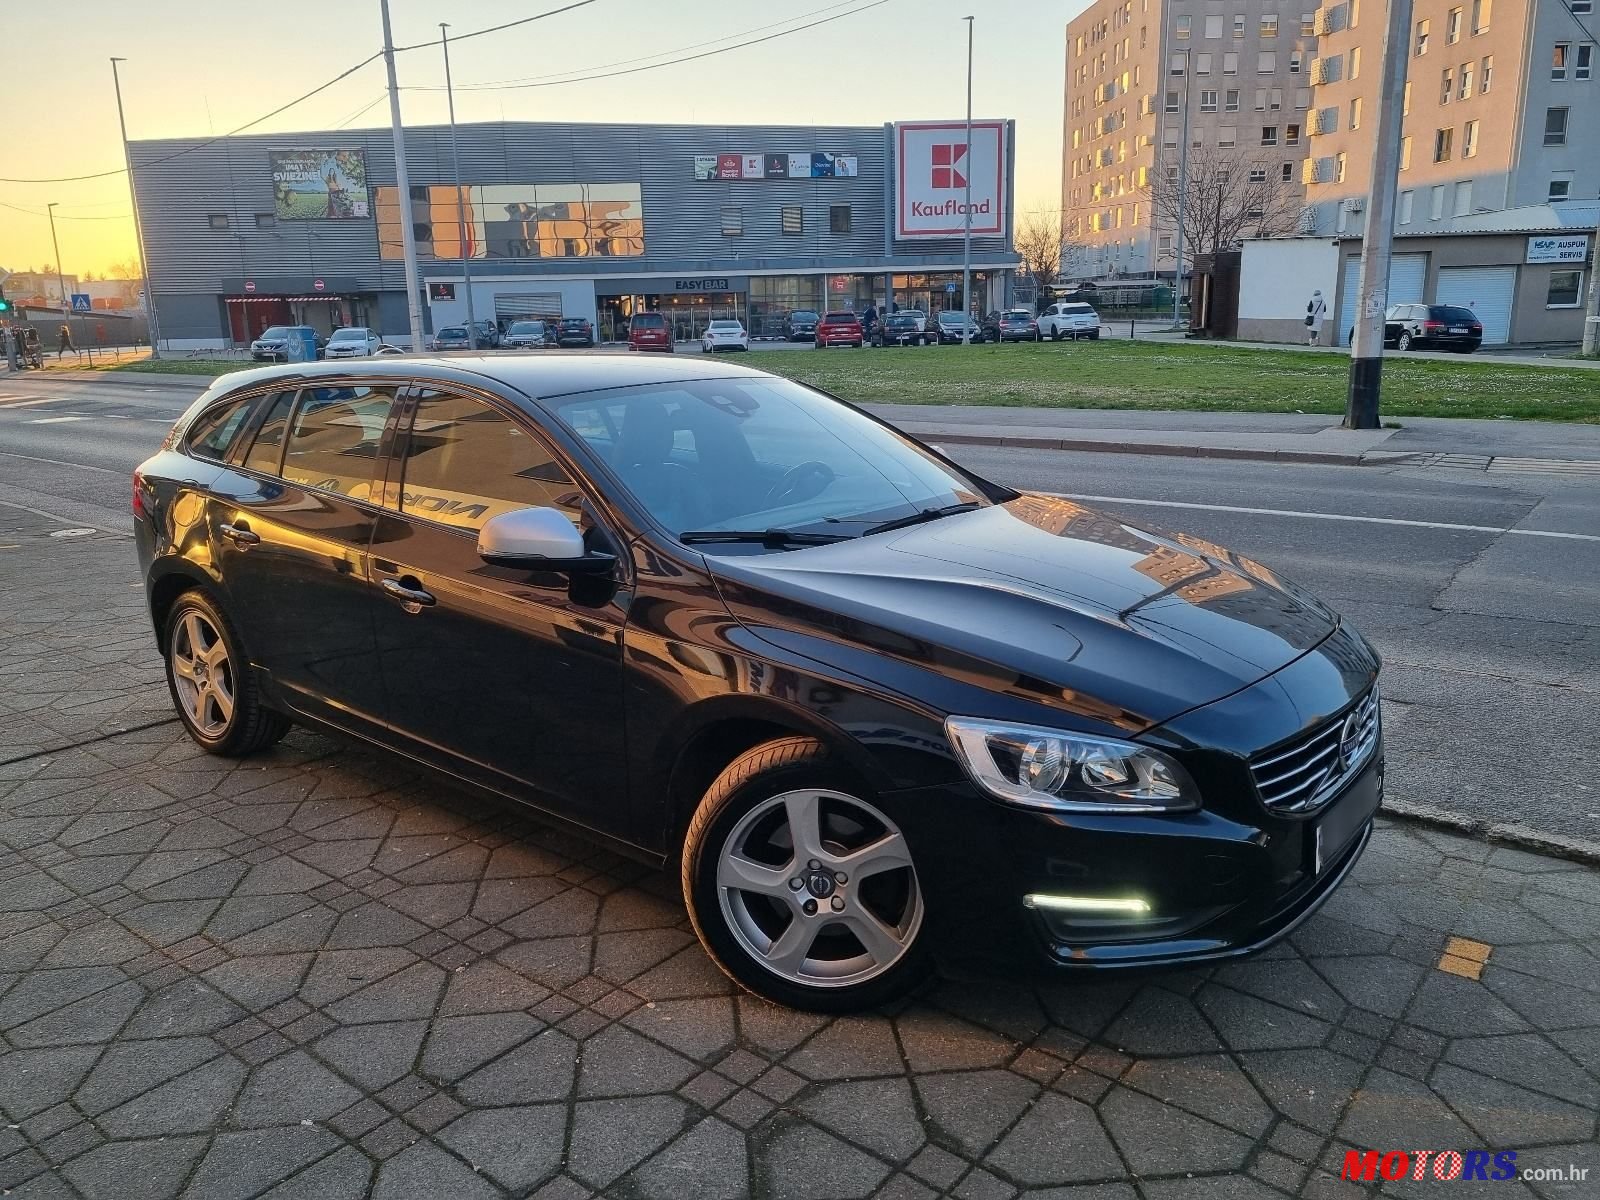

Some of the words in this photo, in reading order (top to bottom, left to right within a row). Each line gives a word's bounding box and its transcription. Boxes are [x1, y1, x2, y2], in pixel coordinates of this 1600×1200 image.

[911, 198, 990, 217] Kaufland
[1557, 240, 1586, 249] AUSPUH
[1559, 251, 1583, 259] SERVIS
[675, 280, 702, 290] EASY
[704, 280, 727, 289] BAR
